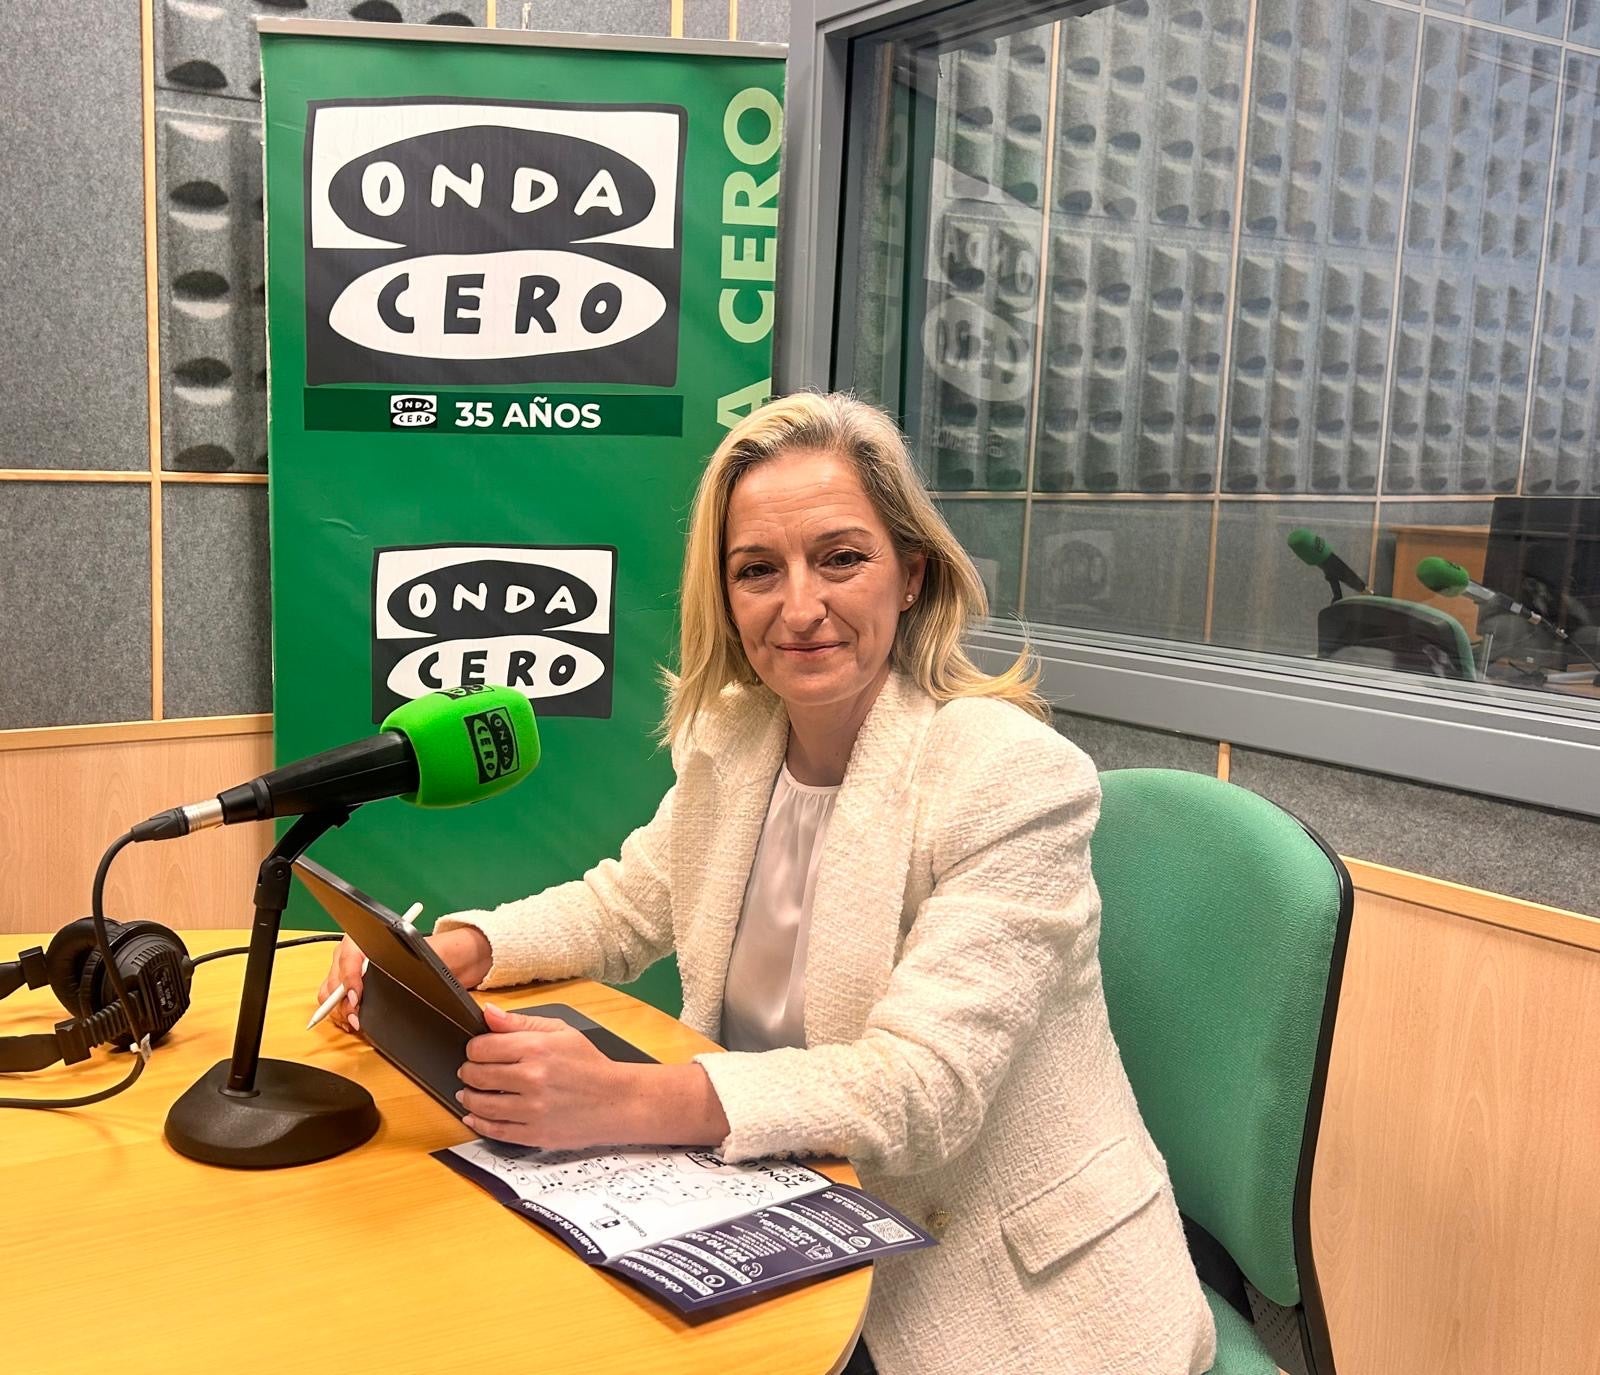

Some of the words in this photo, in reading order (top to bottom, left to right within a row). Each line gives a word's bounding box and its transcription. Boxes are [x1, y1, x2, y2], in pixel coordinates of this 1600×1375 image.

[361, 161, 623, 217] ONDA
[718, 87, 784, 343] CERO
[377, 273, 623, 335] CERO
[396, 401, 431, 410] ONDA
[399, 414, 430, 424] CERO
[455, 402, 494, 427] 35
[502, 396, 602, 428] AÑOS
[408, 583, 577, 618] ONDA
[418, 650, 576, 689] CERO
[477, 725, 496, 771] CERO
[494, 719, 510, 765] ONDA
